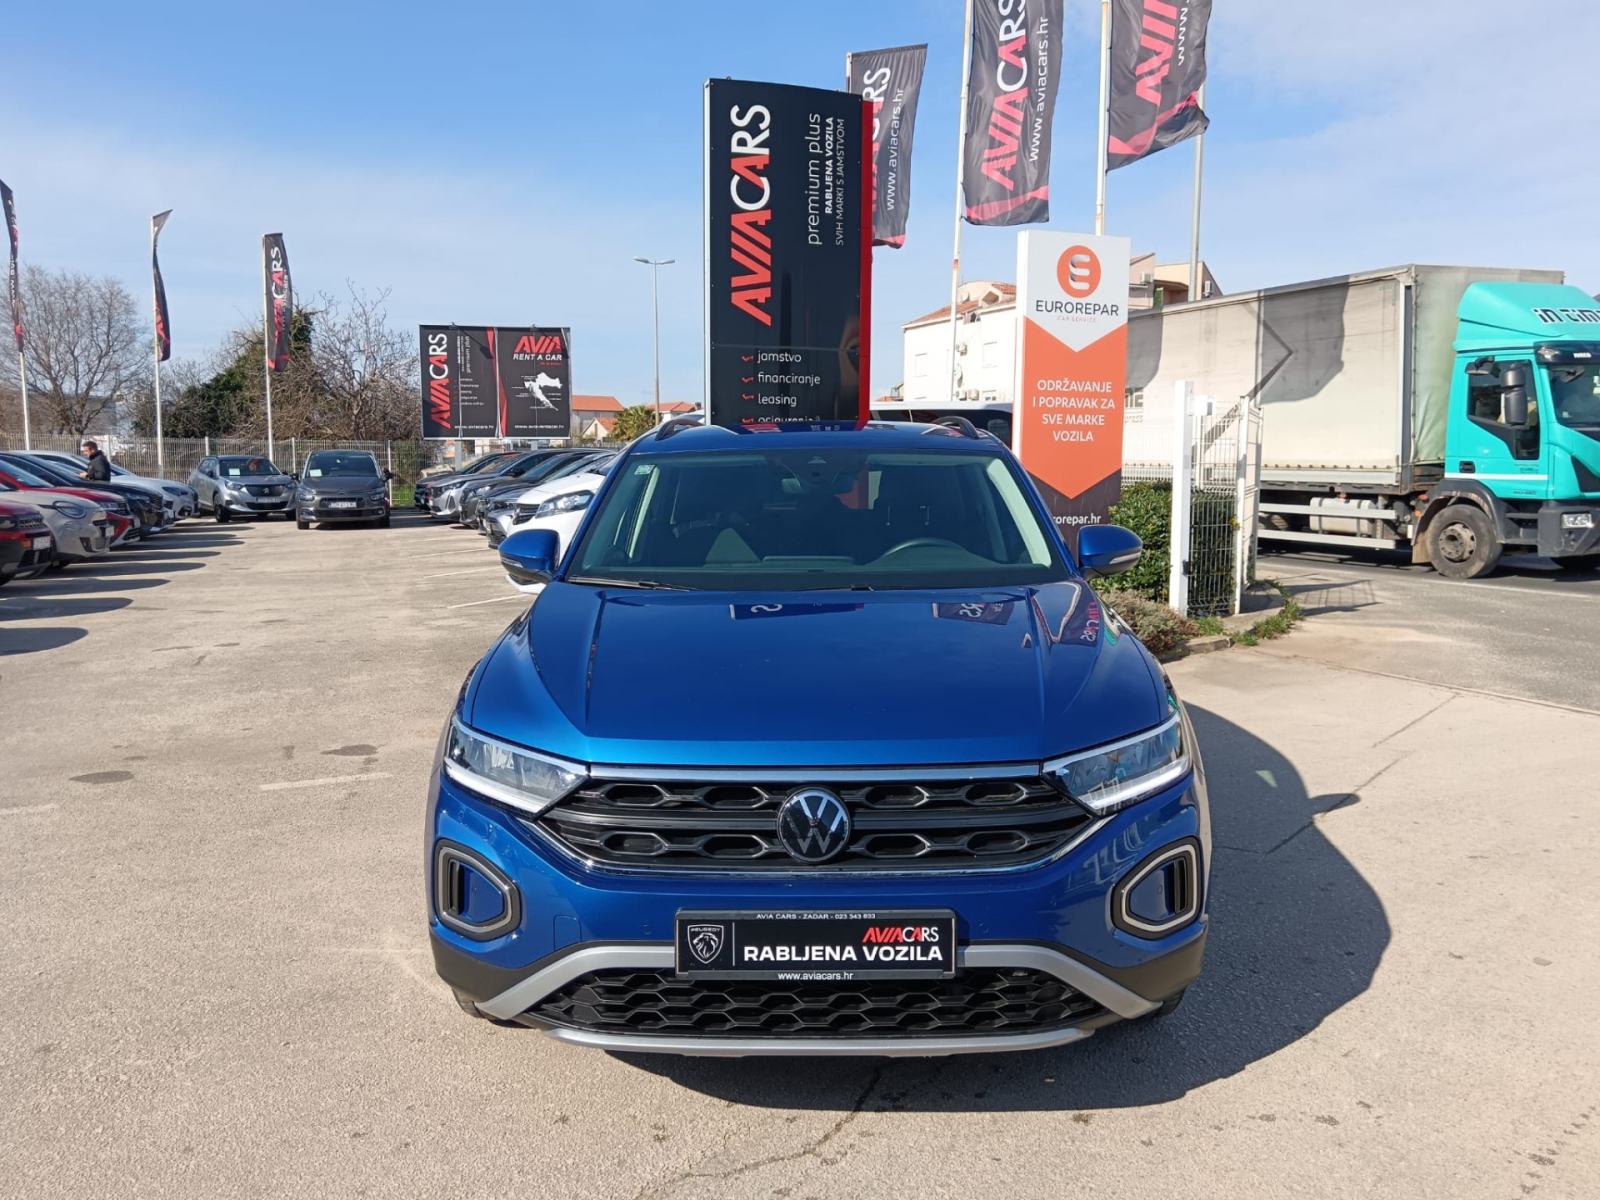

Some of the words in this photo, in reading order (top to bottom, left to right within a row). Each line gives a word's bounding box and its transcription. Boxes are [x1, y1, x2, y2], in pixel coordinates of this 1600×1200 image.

[1029, 17, 1048, 161] www.aviacars.hr
[804, 113, 823, 153] plus
[825, 117, 834, 157] VOZILA
[836, 119, 845, 177] JAMSTVOM
[887, 89, 905, 212] www.aviacars.hr
[825, 160, 833, 214] RABLJENA
[805, 160, 822, 245] premium
[835, 188, 844, 220] MARKI
[730, 104, 772, 327] AVIACARS
[835, 222, 844, 246] SVIH
[1036, 300, 1119, 316] EUROREPAR
[514, 335, 562, 353] AVIA
[757, 350, 802, 364] jamstvo
[428, 333, 451, 429] AVIACARS
[758, 371, 821, 386] financiranje
[1037, 378, 1112, 393] ODRŽAVANJE
[758, 393, 797, 407] leasing
[1040, 397, 1099, 409] POPRAVAK
[1100, 398, 1115, 409] ZA
[1042, 413, 1063, 425] SVE
[1065, 414, 1105, 426] MARKE
[1053, 430, 1094, 442] VOZILA
[862, 927, 939, 943] AVIACARS
[744, 946, 858, 961] RABLJENA
[863, 946, 943, 961] VOZILA
[778, 971, 854, 981] www.aviacars.hr
